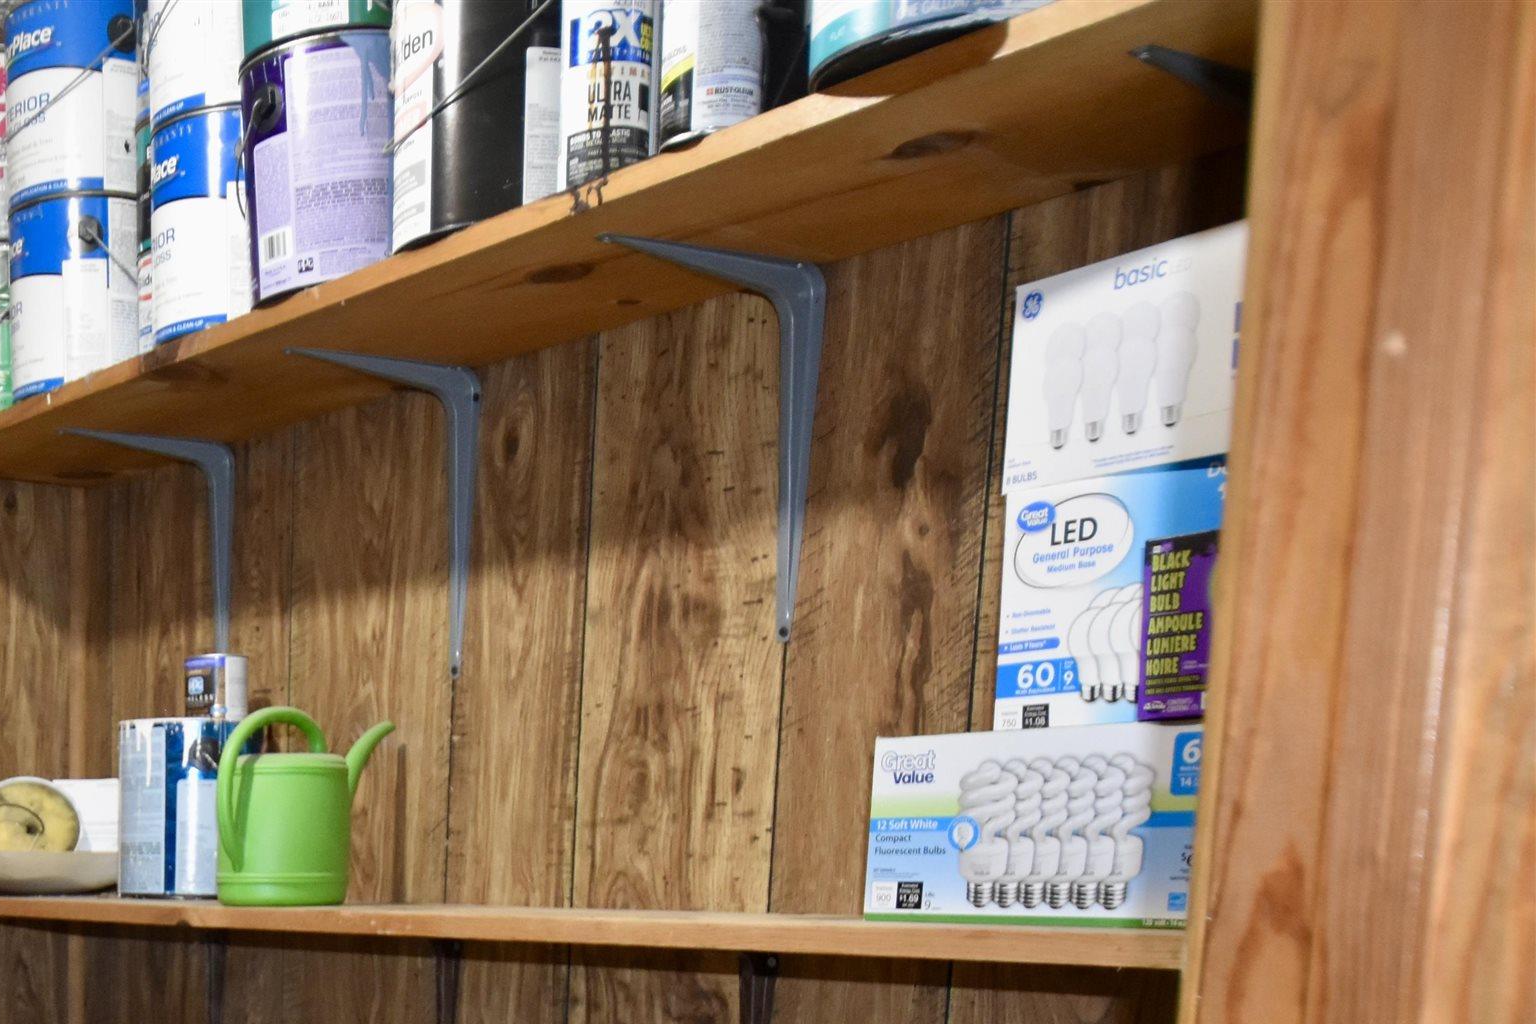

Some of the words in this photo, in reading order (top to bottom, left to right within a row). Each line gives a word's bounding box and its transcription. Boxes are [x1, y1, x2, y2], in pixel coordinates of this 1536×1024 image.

[1113, 257, 1169, 290] basic
[1012, 470, 1039, 485] BULBS
[1019, 507, 1049, 521] Great
[1050, 516, 1098, 547] LED
[1032, 548, 1070, 564] General
[1073, 543, 1115, 558] Purpose
[1151, 549, 1192, 573] BLACK
[1046, 562, 1076, 574] Medium
[1077, 559, 1097, 570] Base
[1150, 571, 1186, 593] LIGHT
[1150, 592, 1182, 613] BULB
[1148, 612, 1204, 635] AMPOULE
[1016, 661, 1056, 690] 60
[1146, 656, 1180, 677] NOIRE
[1064, 670, 1074, 686] 9
[881, 749, 937, 773] Great
[893, 771, 935, 785] Value
[877, 820, 885, 831] 12
[888, 818, 909, 831] Soft
[909, 818, 939, 831] White
[875, 833, 912, 845] Compact
[874, 846, 922, 856] Fluorescent
[923, 845, 947, 856] Bulbs
[899, 893, 920, 904] $1.69
[924, 899, 932, 911] 9
